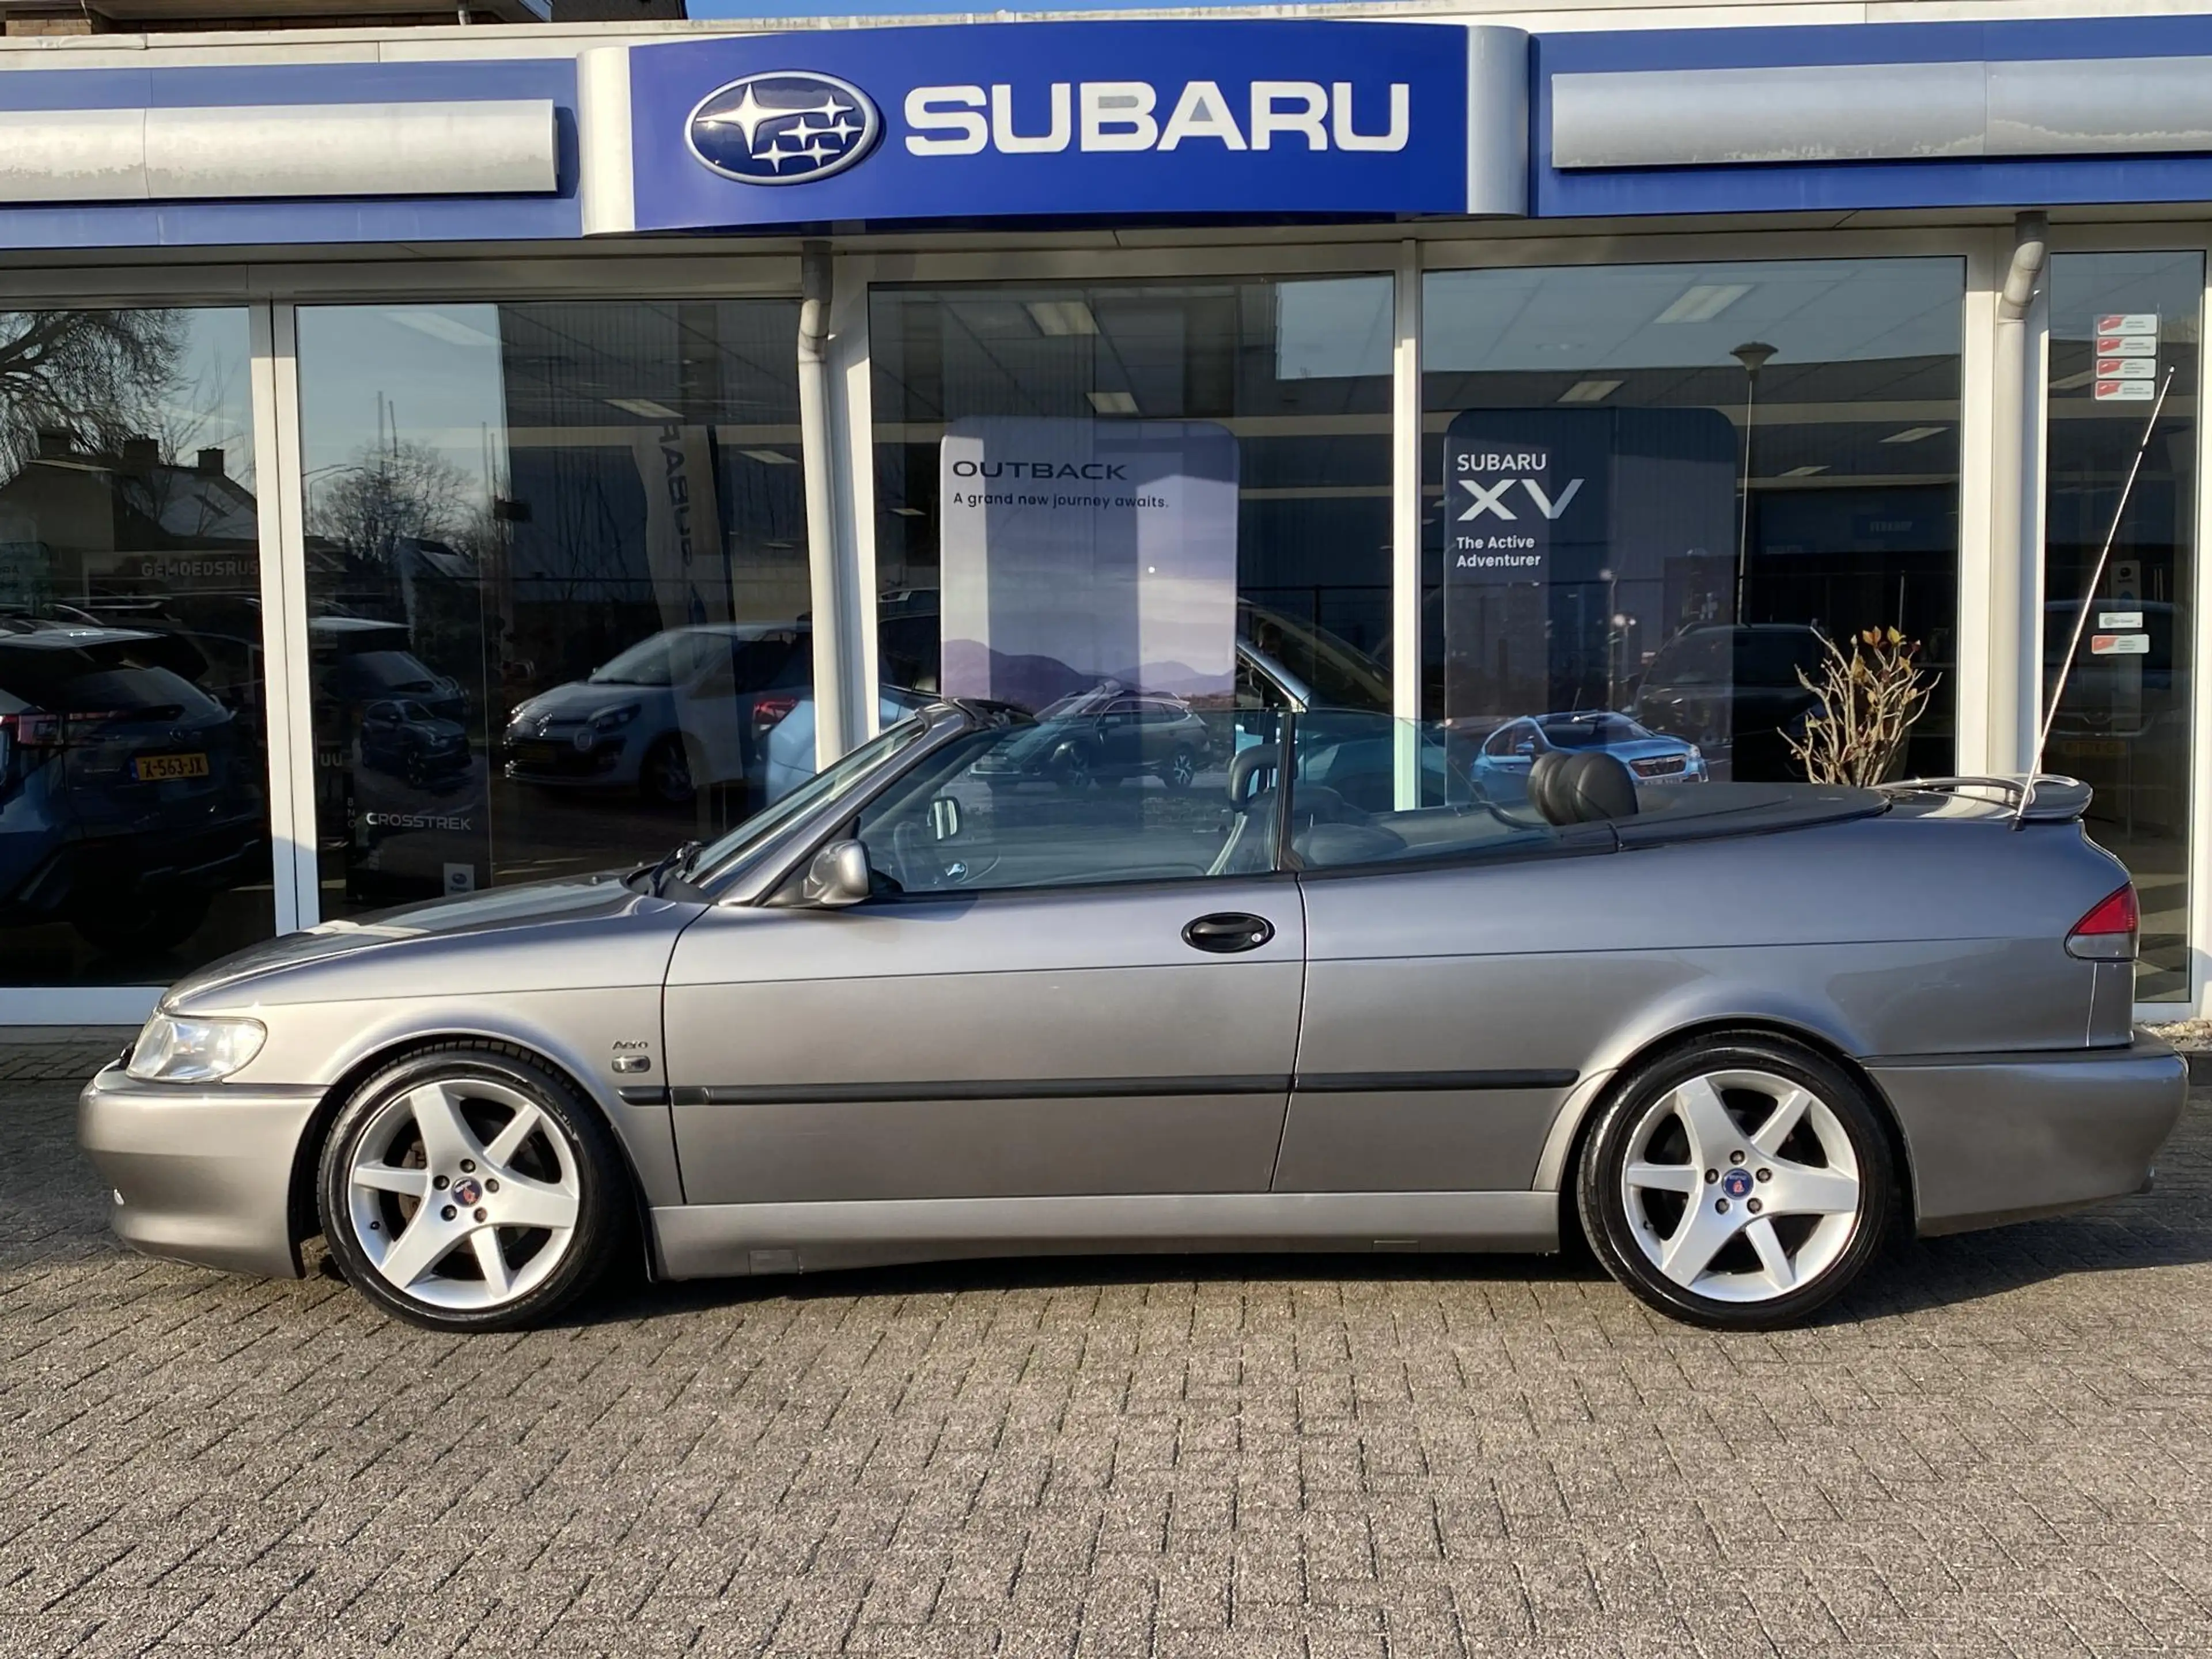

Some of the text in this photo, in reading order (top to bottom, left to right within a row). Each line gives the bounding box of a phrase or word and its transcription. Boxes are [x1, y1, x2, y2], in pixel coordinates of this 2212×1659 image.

[905, 81, 1410, 156] SUBARU
[953, 461, 1127, 480] OUTBACK
[1457, 453, 1547, 471] SUBARU
[953, 493, 1169, 510] A grand new journey awaits.
[1457, 479, 1584, 521] XV
[1456, 535, 1535, 548] The Active
[1456, 554, 1541, 567] Adventurer
[366, 812, 472, 831] CROSSTREK
